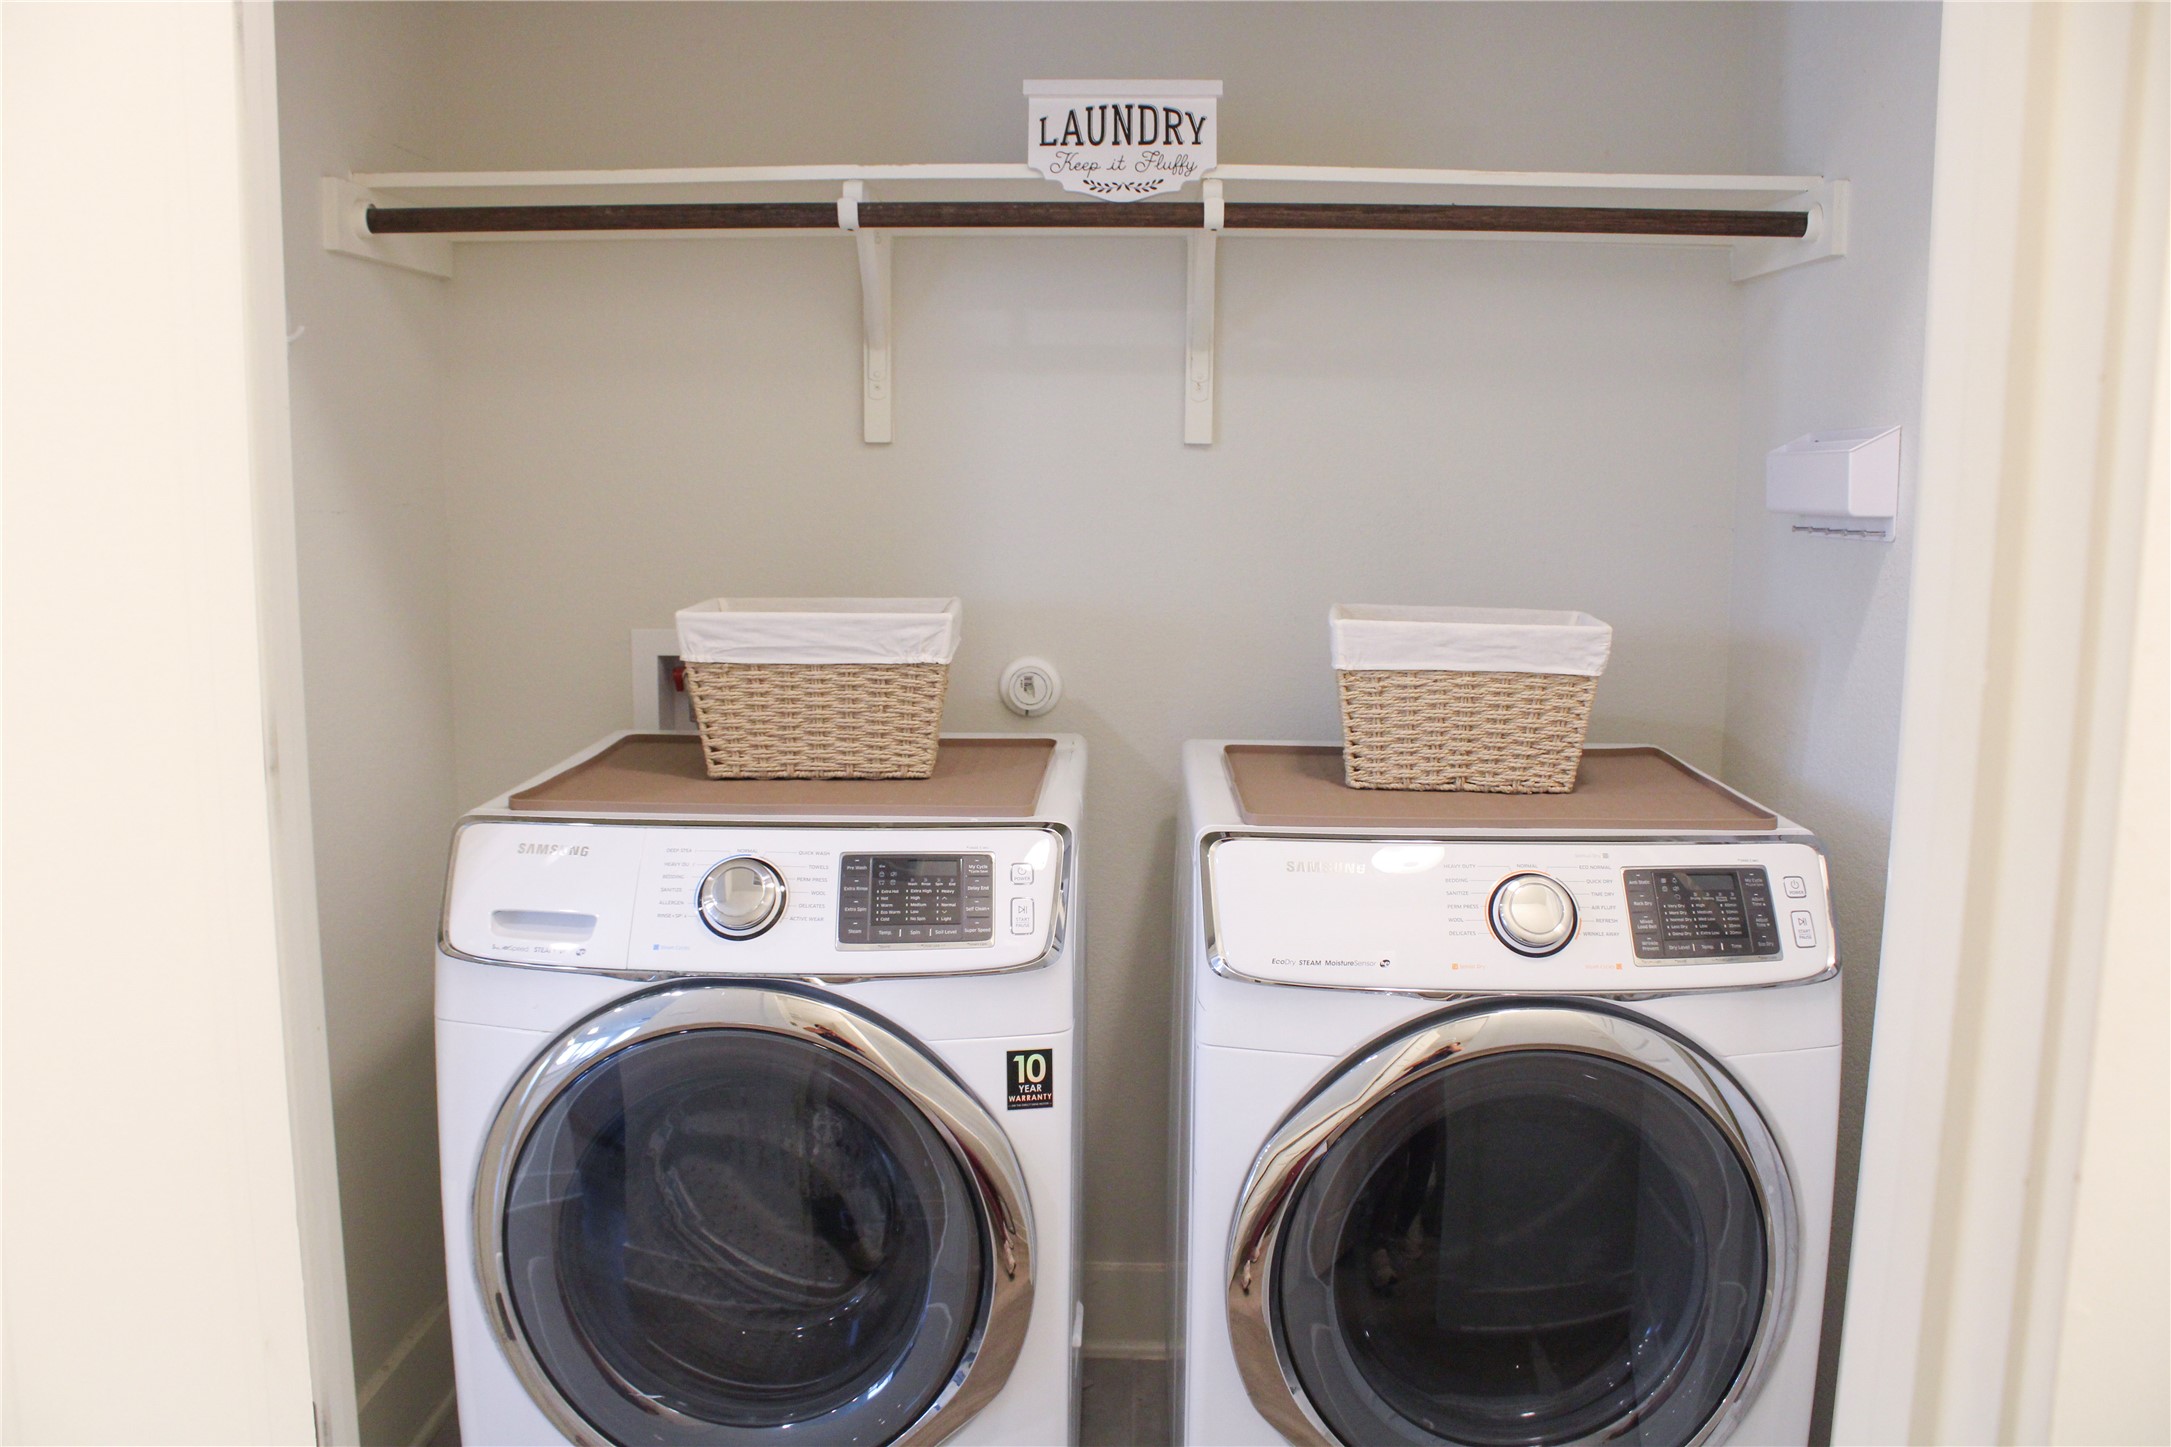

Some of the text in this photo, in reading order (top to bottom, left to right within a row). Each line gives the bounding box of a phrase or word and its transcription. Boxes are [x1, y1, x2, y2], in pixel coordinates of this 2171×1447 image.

[1039, 103, 1207, 147] LAUNDRY
[1050, 151, 1198, 178] Keep it Fluffy
[517, 842, 590, 857] SAMSNG
[1286, 860, 1366, 874] SAMSUNG
[1271, 957, 1297, 967] EcoDry
[1324, 959, 1377, 967] MoistureSensor
[1013, 1053, 1046, 1084] 10
[1018, 1084, 1042, 1093] YEAR
[1008, 1093, 1052, 1102] WARRANTY
